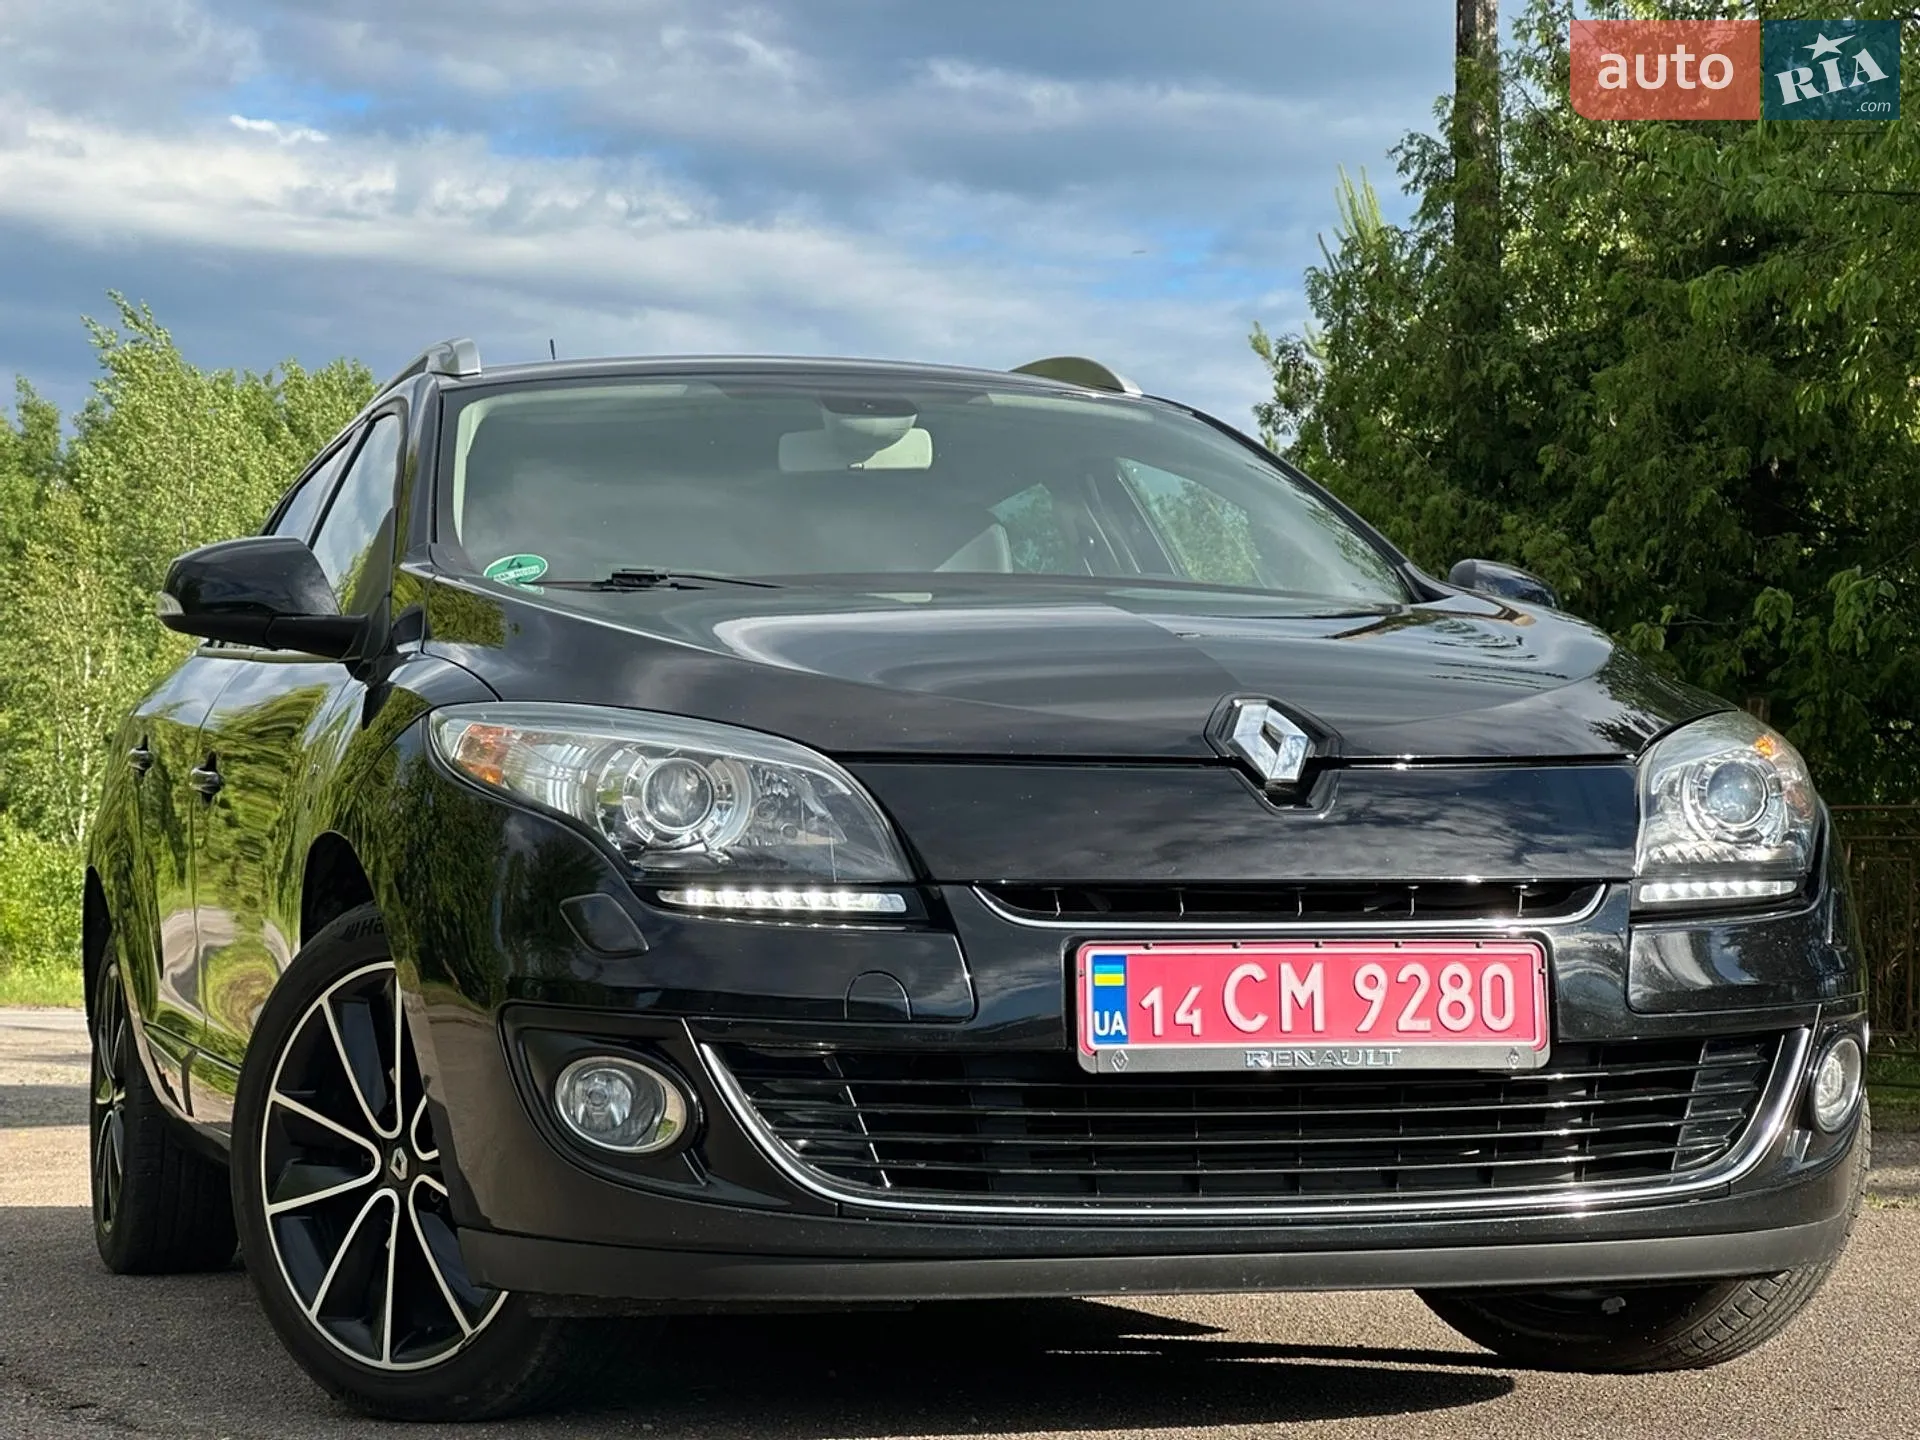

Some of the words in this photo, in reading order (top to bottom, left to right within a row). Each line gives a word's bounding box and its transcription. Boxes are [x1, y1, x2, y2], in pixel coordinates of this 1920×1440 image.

[1139, 985, 1202, 1036] 14
[1223, 962, 1325, 1034] CM
[1354, 962, 1516, 1033] 9280
[1094, 1010, 1127, 1036] UA
[1245, 1048, 1402, 1068] RENAULT
